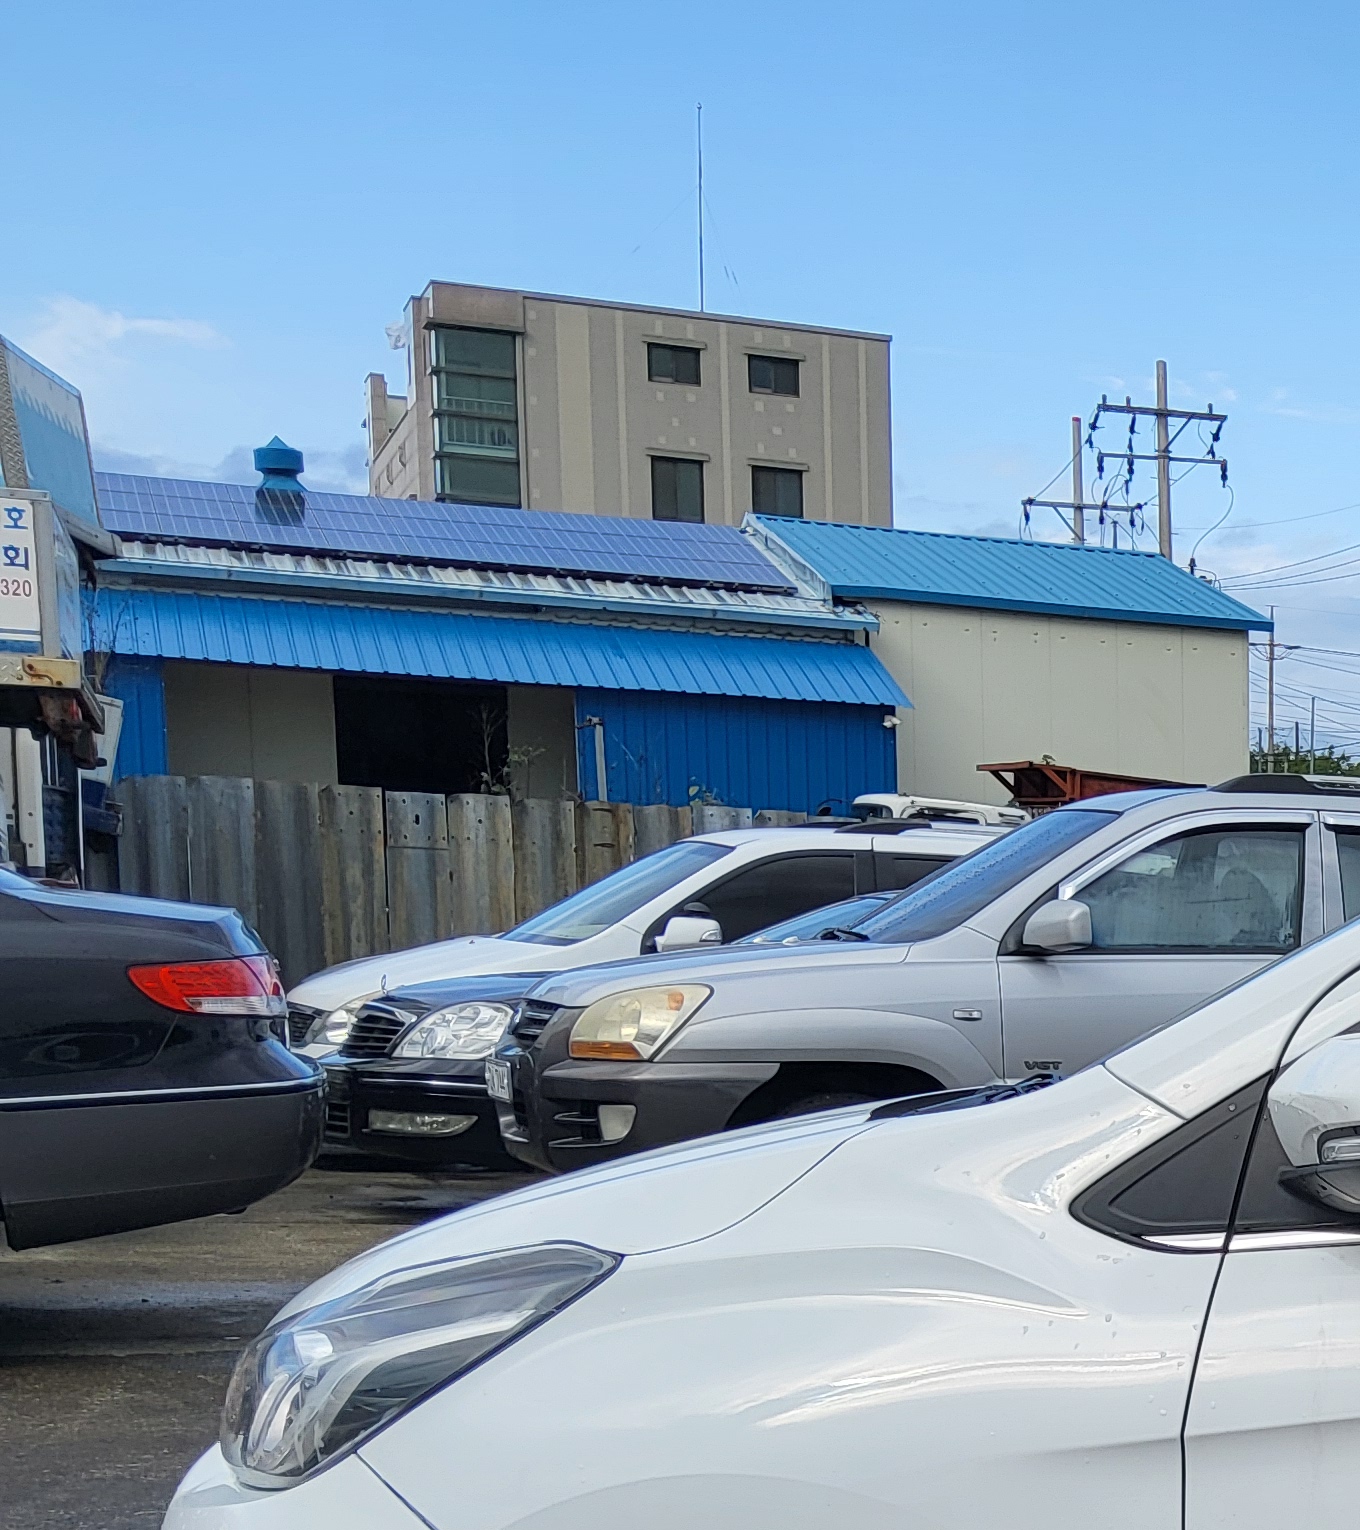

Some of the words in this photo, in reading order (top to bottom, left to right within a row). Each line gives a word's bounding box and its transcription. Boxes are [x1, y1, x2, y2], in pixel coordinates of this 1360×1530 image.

[4, 506, 28, 529] 호
[2, 544, 29, 571] 회
[0, 578, 32, 597] 320
